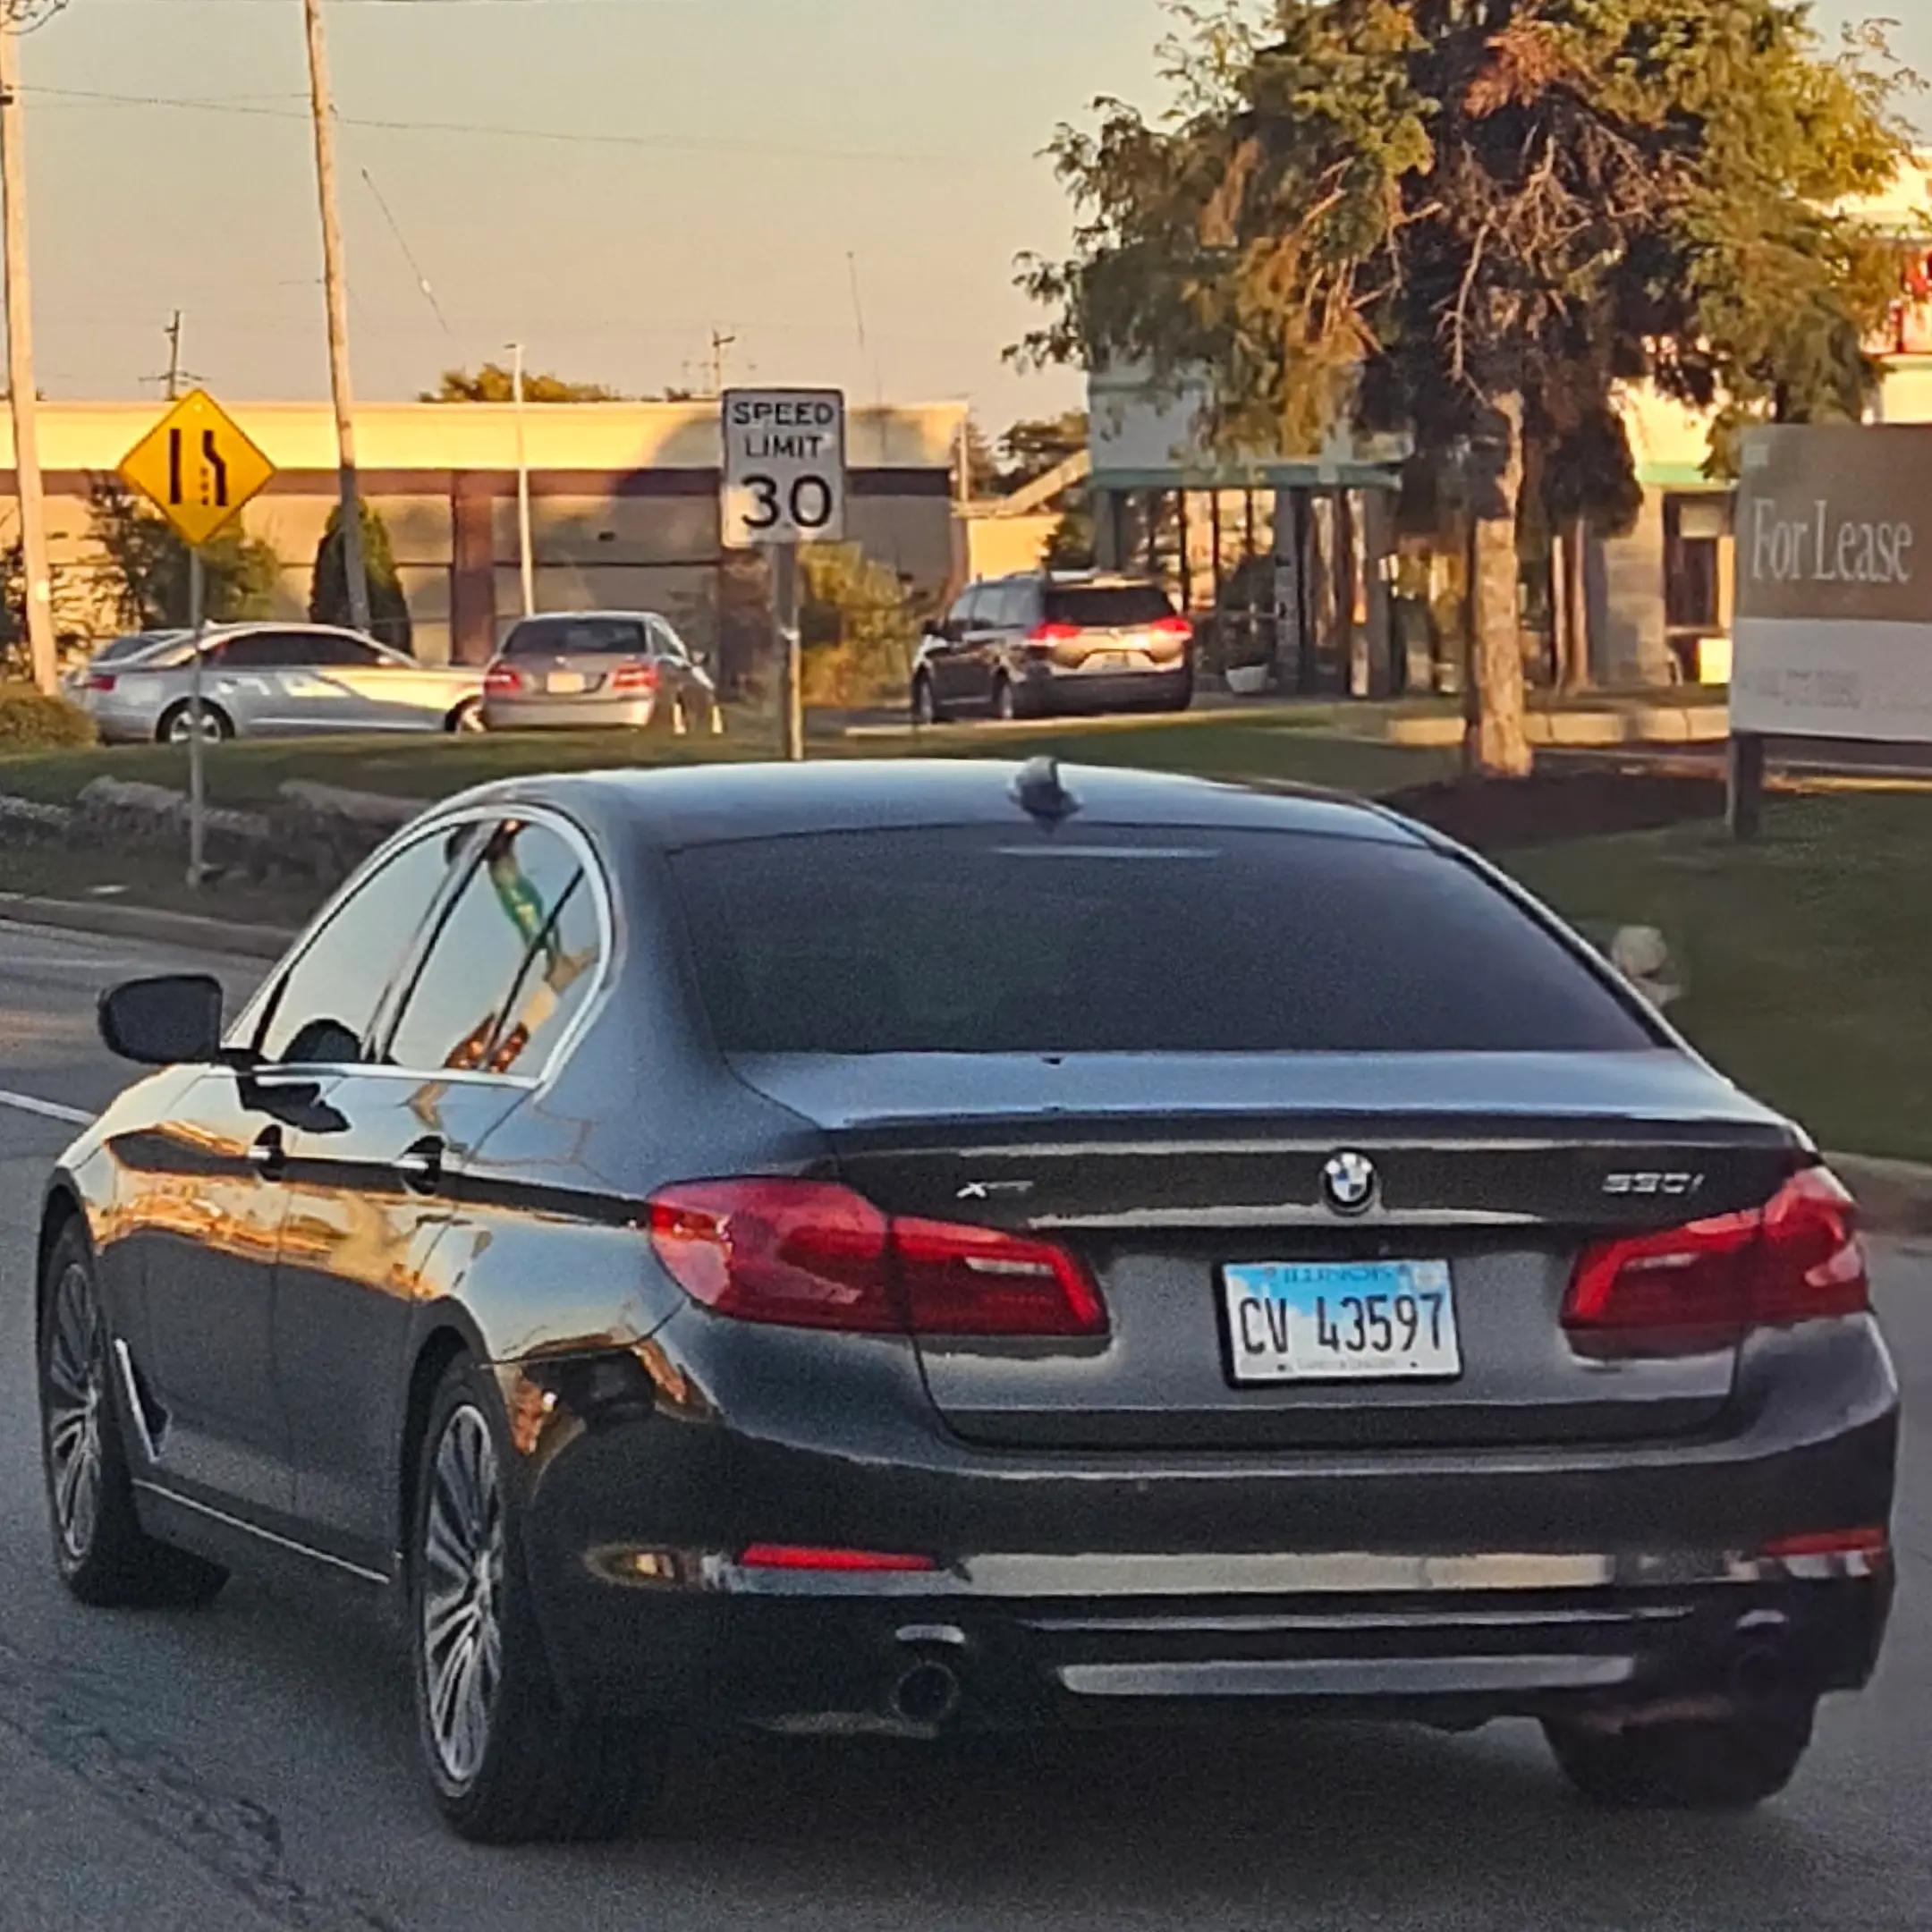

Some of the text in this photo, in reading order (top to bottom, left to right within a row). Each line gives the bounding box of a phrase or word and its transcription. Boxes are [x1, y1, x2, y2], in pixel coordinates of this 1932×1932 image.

[733, 402, 834, 426] SPEED
[745, 435, 823, 458] LIMIT
[741, 474, 832, 529] 30
[1751, 498, 1913, 584] For Lease
[1240, 1292, 1444, 1355] CV 43597
